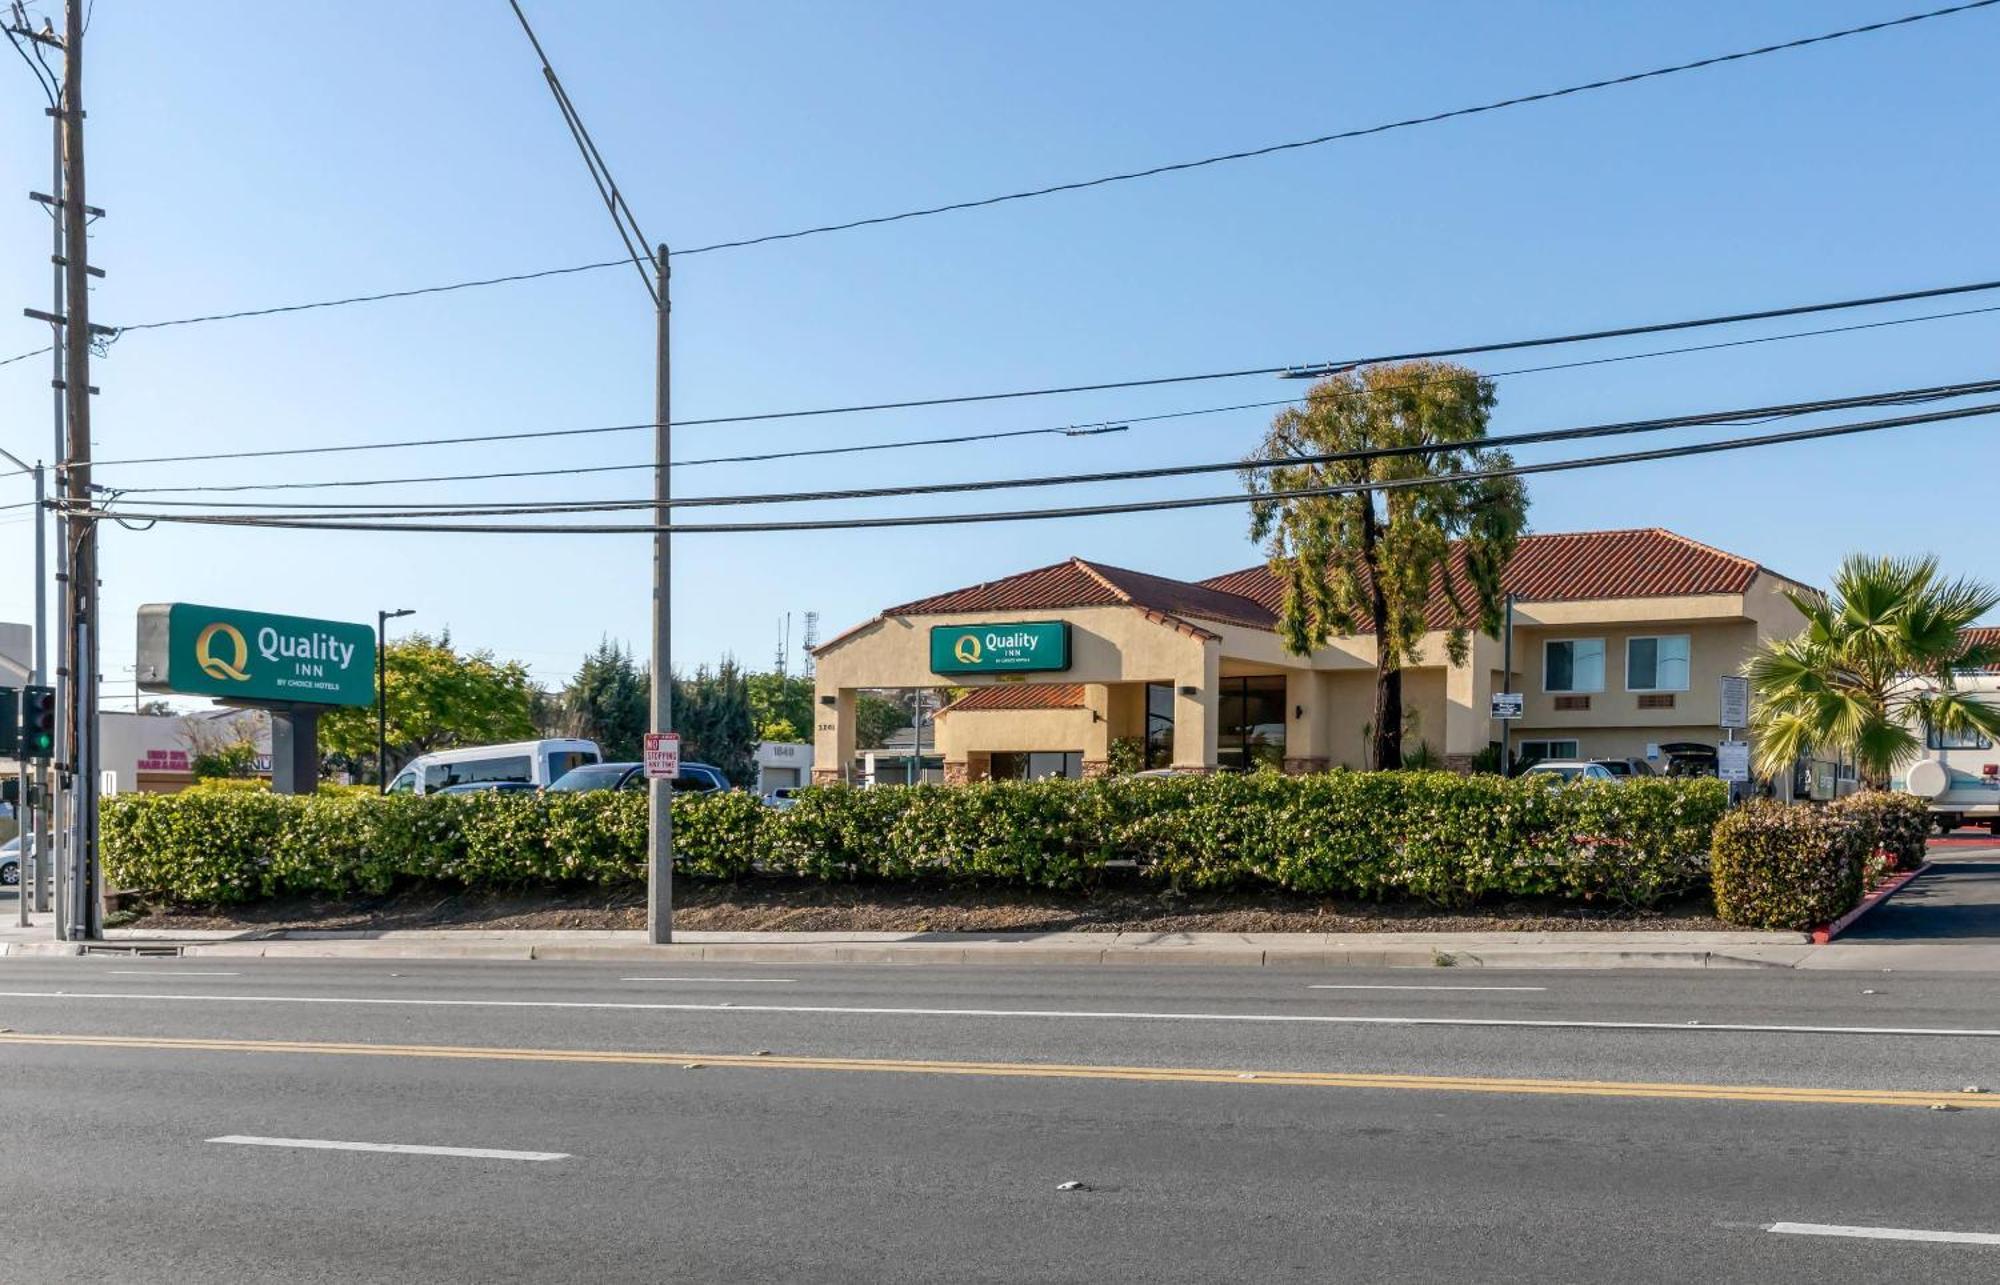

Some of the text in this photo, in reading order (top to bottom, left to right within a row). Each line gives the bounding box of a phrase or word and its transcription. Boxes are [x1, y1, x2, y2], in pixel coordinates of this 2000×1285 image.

[258, 627, 354, 670] Quality
[955, 635, 982, 663] Q
[986, 633, 1038, 651] Quality
[196, 622, 252, 681] Q
[1005, 649, 1021, 657] INN
[295, 663, 323, 677] INN
[277, 678, 340, 691] BY CHOICE HOTELS
[647, 740, 659, 750] NO
[647, 751, 677, 760] STOPPING
